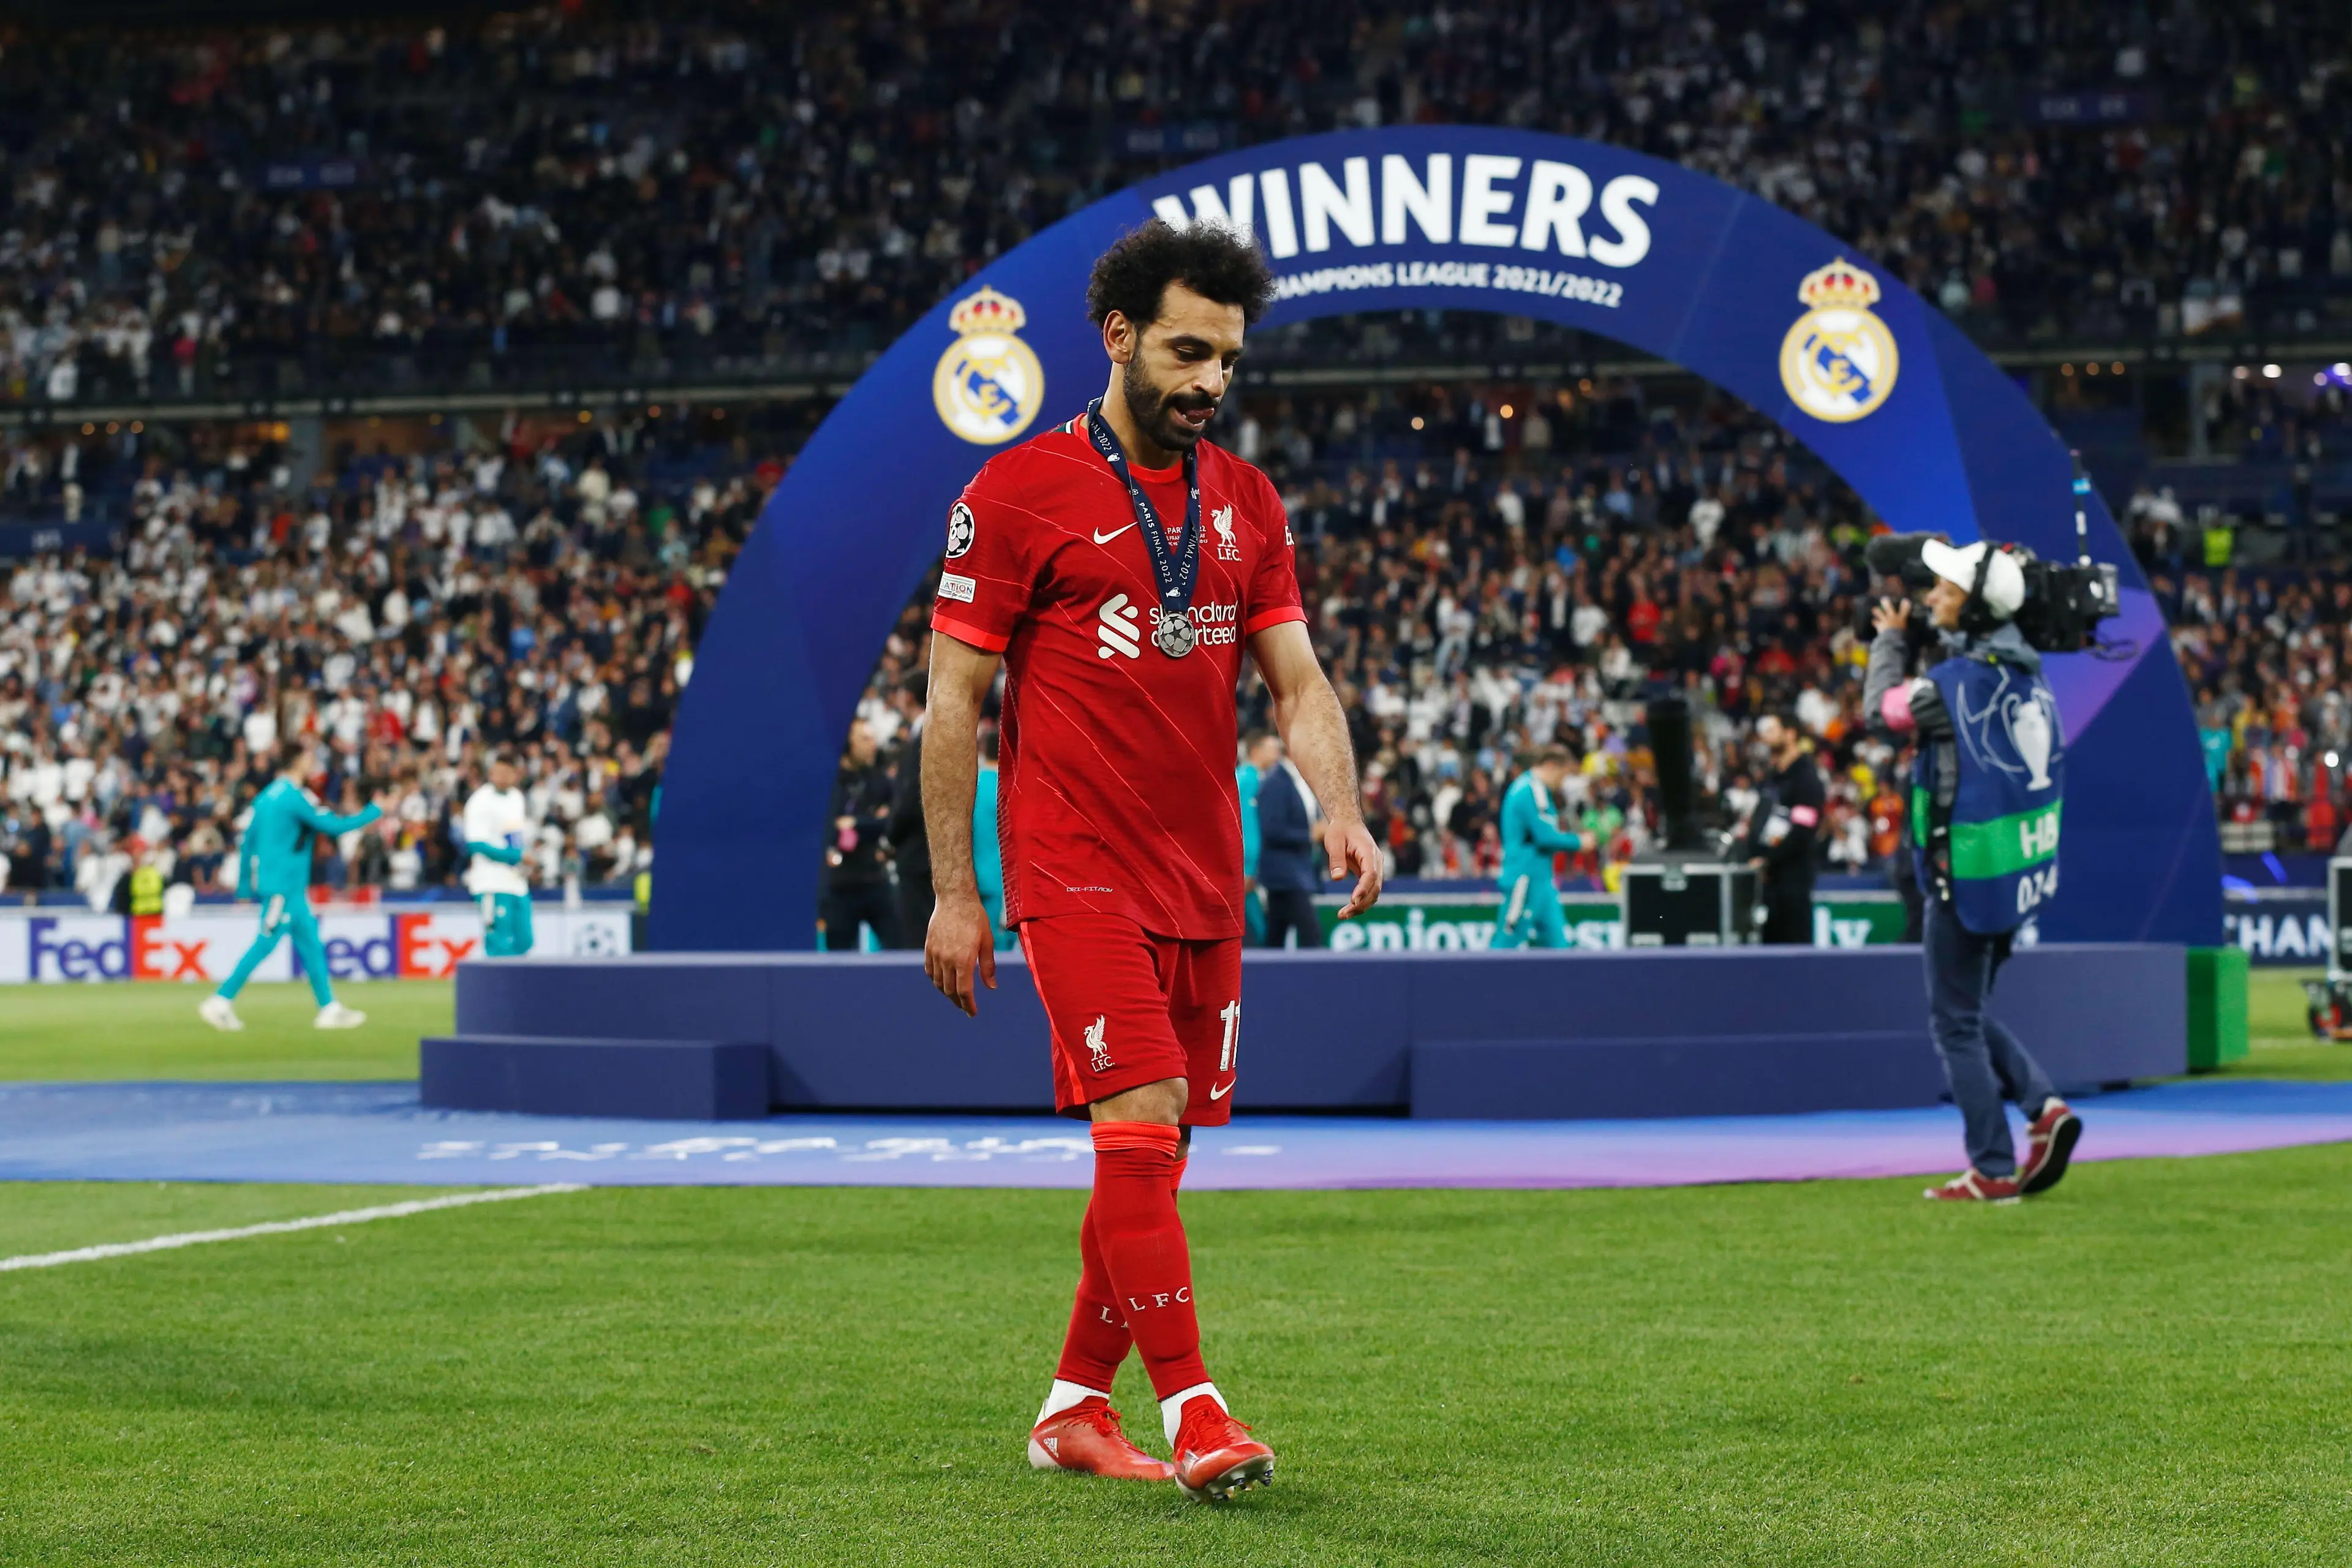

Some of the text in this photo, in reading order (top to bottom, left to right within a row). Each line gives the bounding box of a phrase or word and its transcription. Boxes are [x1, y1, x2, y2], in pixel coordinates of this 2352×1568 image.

[1152, 153, 1660, 268] WINNERS
[1276, 261, 1623, 307] HAMPIONS LEAGUE 2021/2022
[1098, 432, 1112, 451] 2022
[1139, 502, 1173, 584] PARIS FINAL 2022
[1149, 600, 1238, 625] stndard
[29, 914, 209, 981] FedEx
